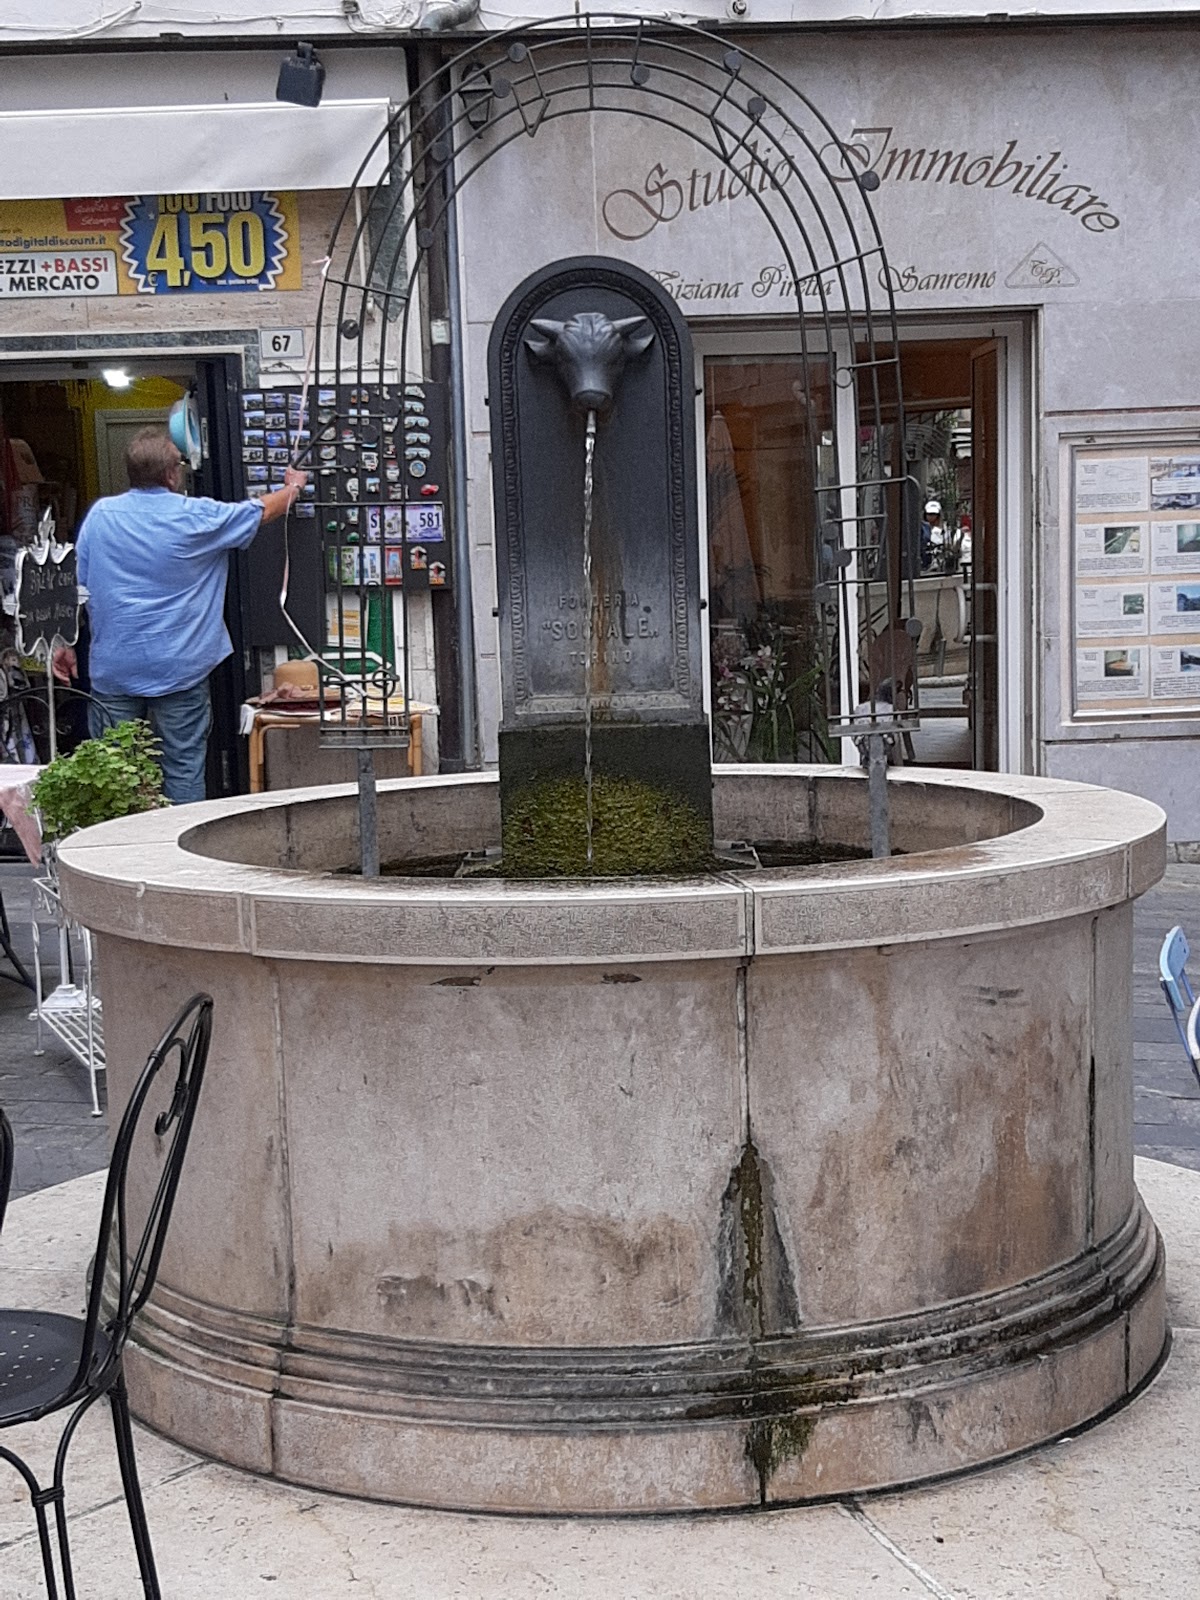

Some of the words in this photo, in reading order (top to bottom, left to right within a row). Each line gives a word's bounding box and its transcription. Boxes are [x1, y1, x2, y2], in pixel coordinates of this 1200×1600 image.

[602, 140, 795, 240] Studio
[819, 127, 1120, 233] Immobiliare
[41, 257, 108, 273] +BASSI
[9, 275, 99, 291] MERCATO
[649, 269, 744, 300] Tiziana
[878, 265, 996, 292] Sanremo
[271, 335, 291, 352] 67
[419, 512, 440, 528] 581
[569, 649, 632, 666] TORINO
